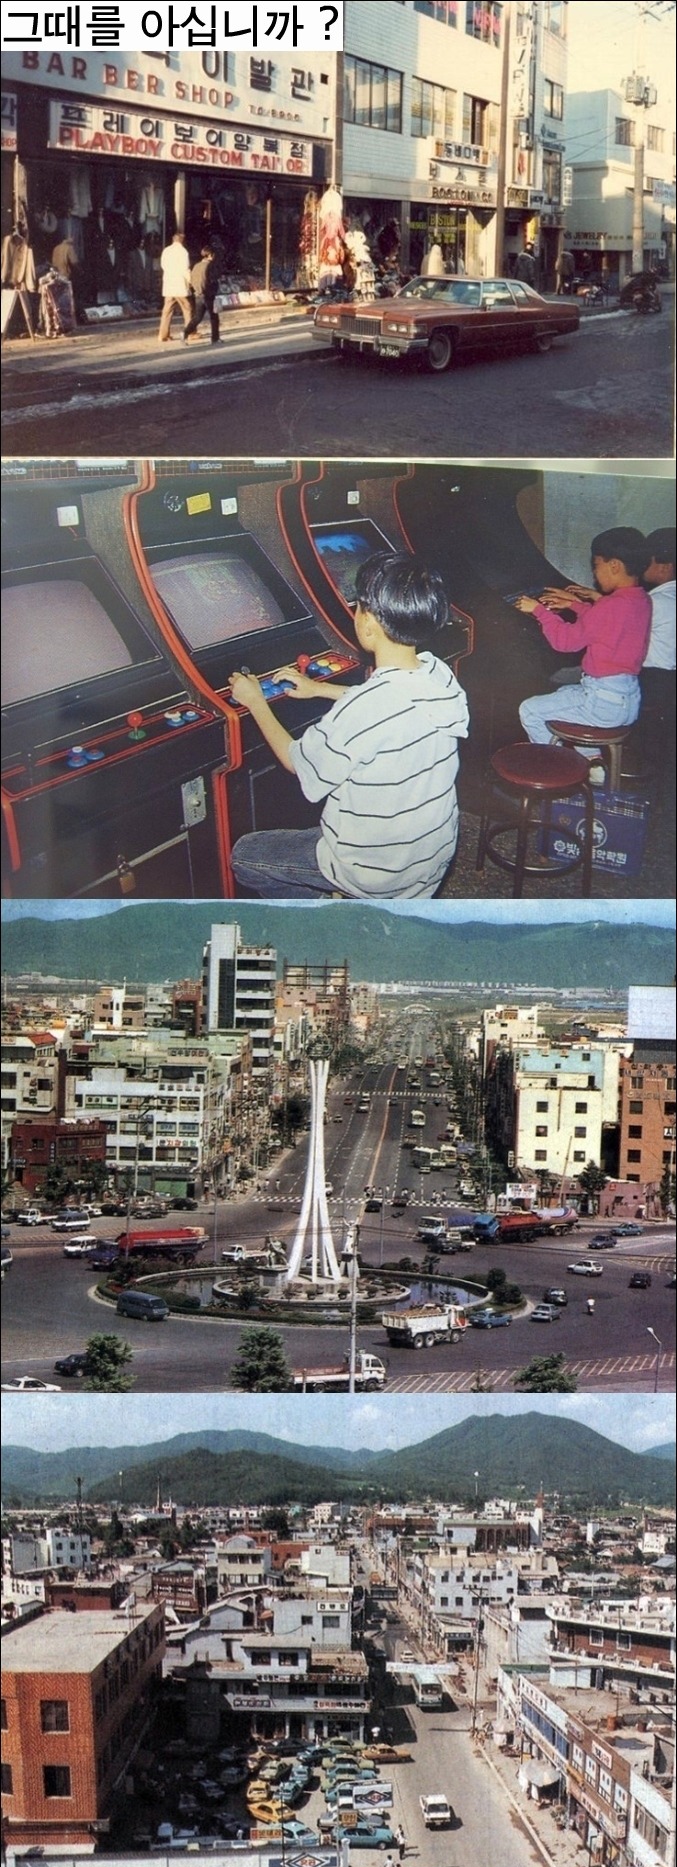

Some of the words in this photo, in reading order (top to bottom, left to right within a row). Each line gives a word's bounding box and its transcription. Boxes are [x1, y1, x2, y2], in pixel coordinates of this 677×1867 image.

[175, 81, 234, 108] SHOP
[58, 127, 162, 156] PLAYBOY
[171, 143, 243, 167] CUSTOM
